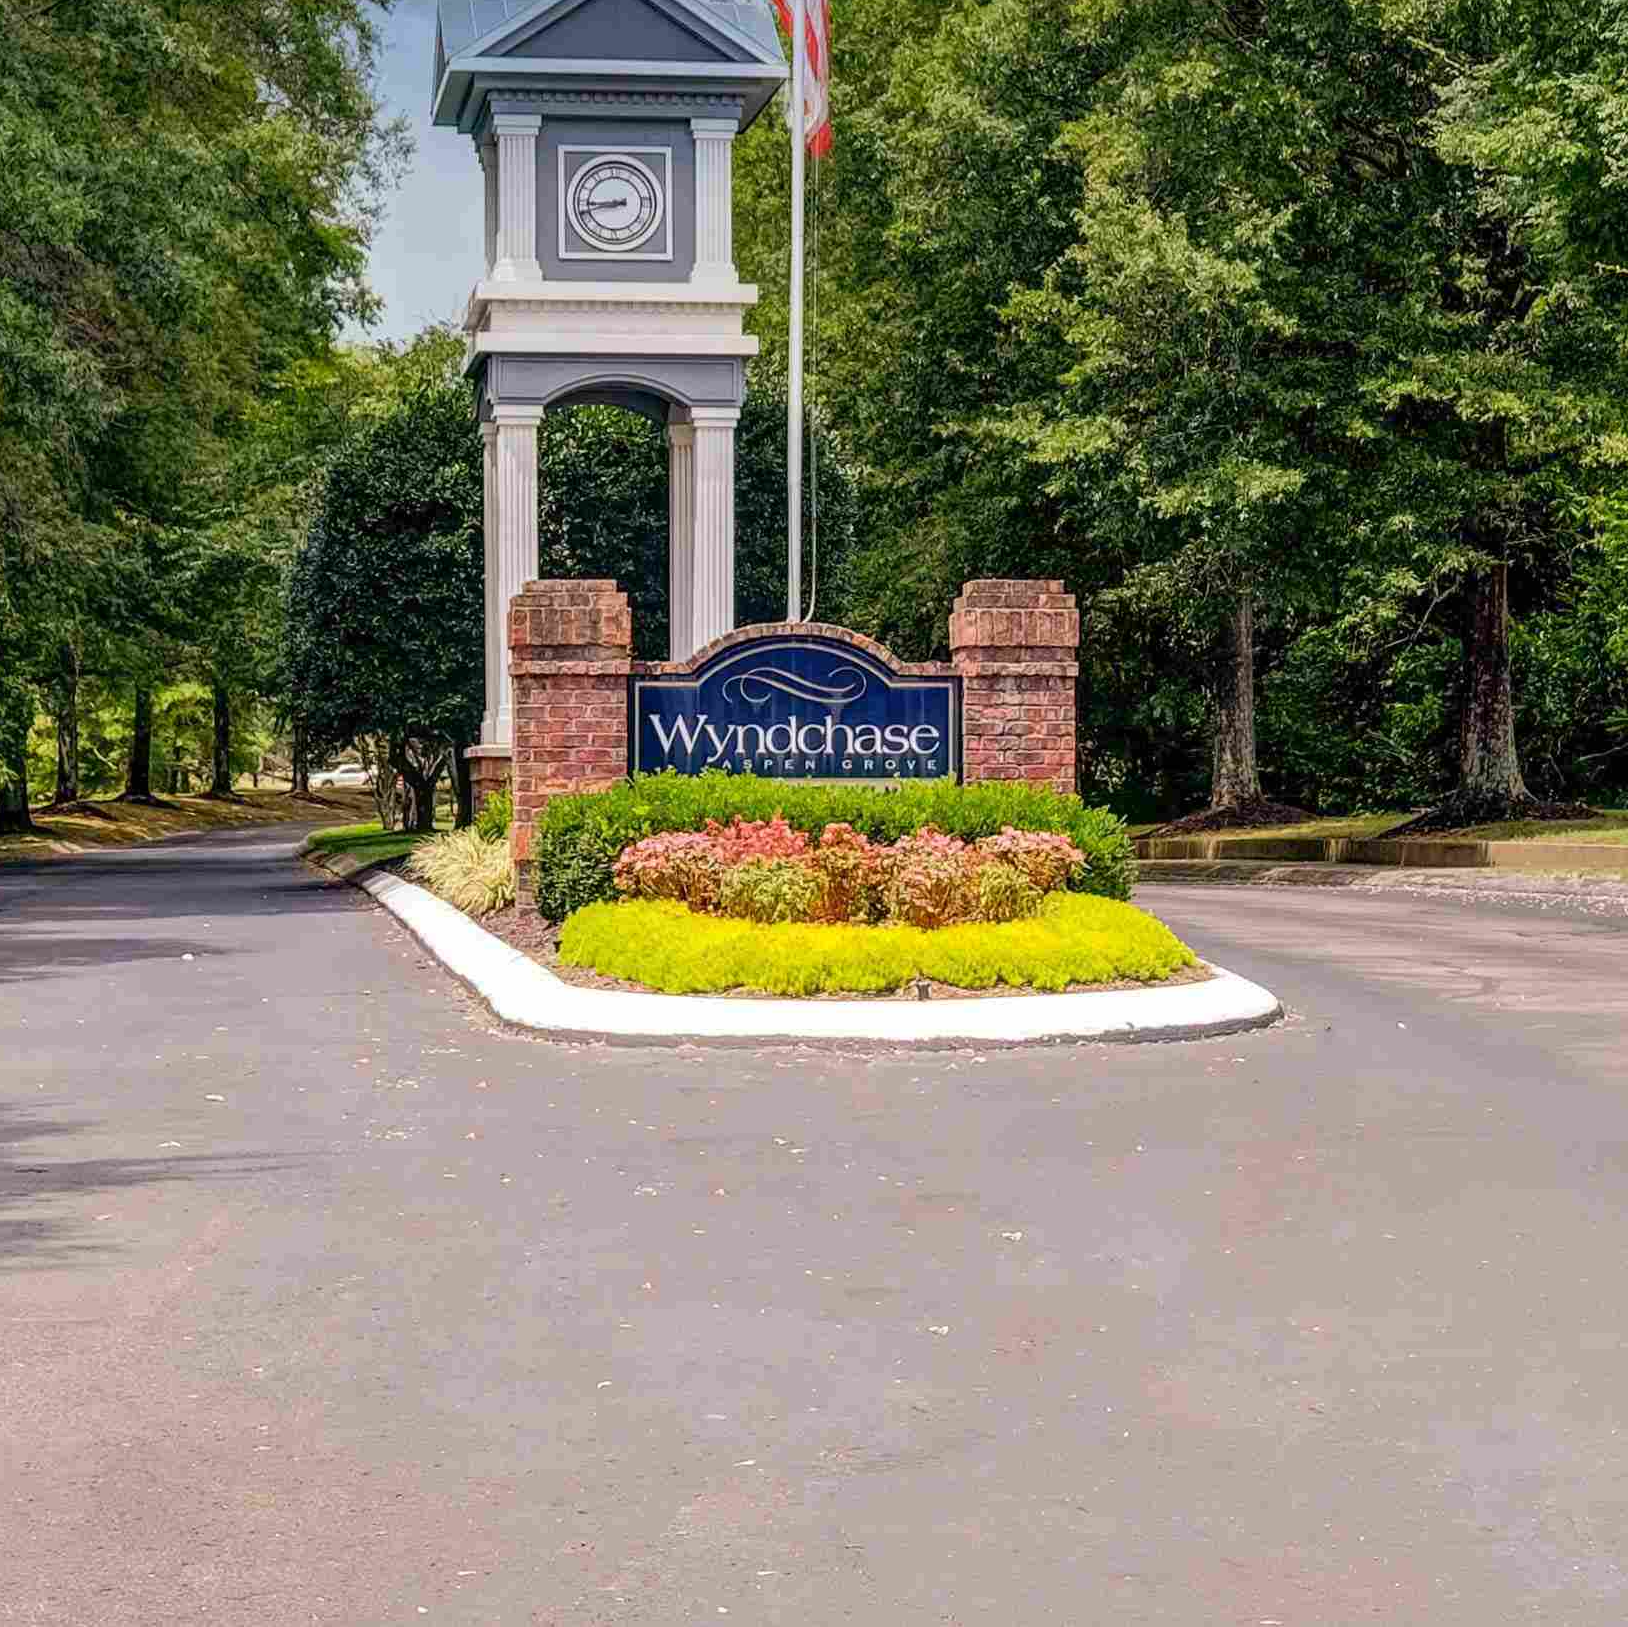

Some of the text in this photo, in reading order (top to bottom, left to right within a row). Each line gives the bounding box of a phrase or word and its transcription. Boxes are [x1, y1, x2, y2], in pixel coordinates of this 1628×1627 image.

[648, 713, 940, 763] Wyndchase
[722, 759, 937, 771] ASPEN GROVE
